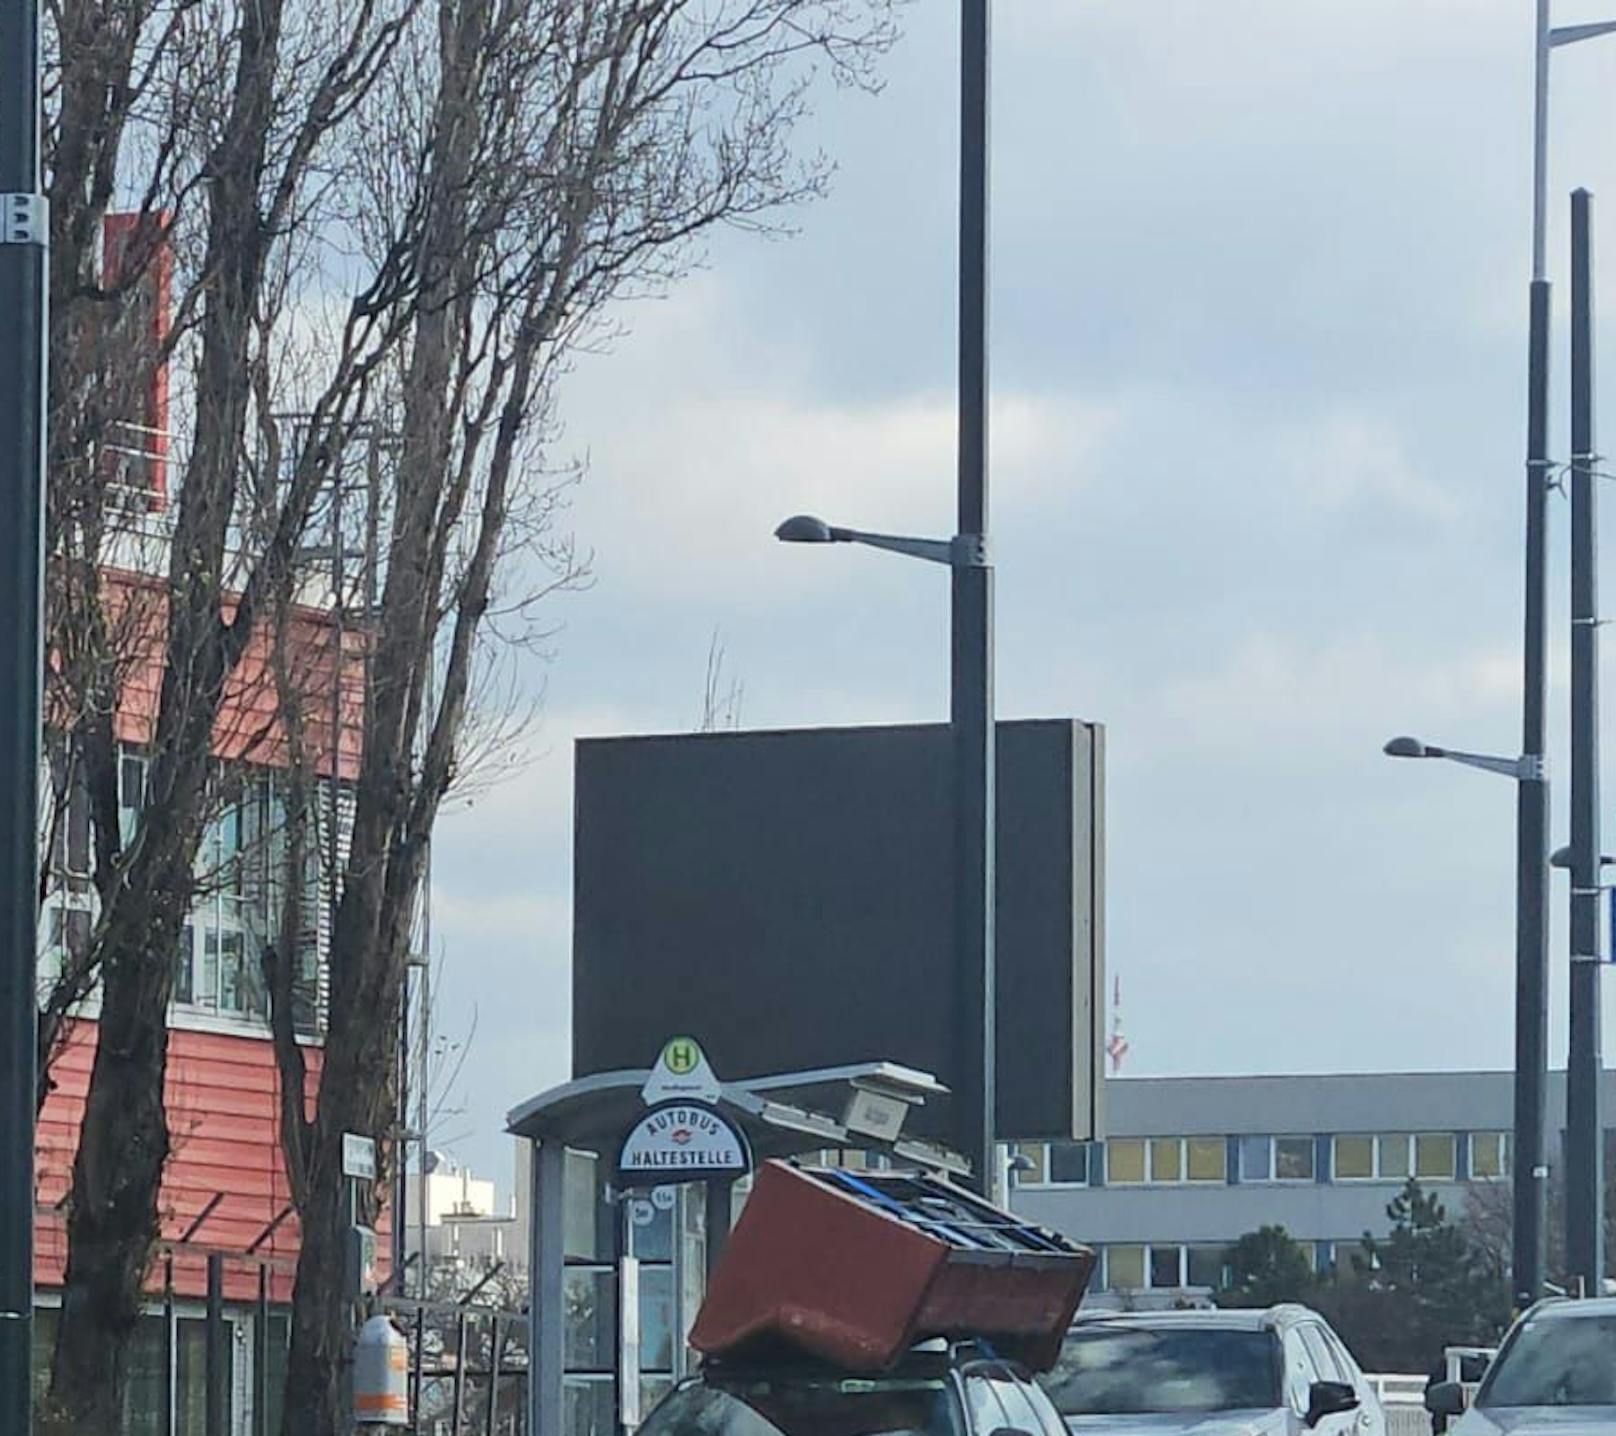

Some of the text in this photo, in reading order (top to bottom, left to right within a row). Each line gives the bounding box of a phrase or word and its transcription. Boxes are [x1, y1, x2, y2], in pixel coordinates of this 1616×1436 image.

[673, 1045, 690, 1067] H
[646, 1110, 721, 1136] AUTOBUS
[632, 1151, 732, 1165] HALTESTELLE
